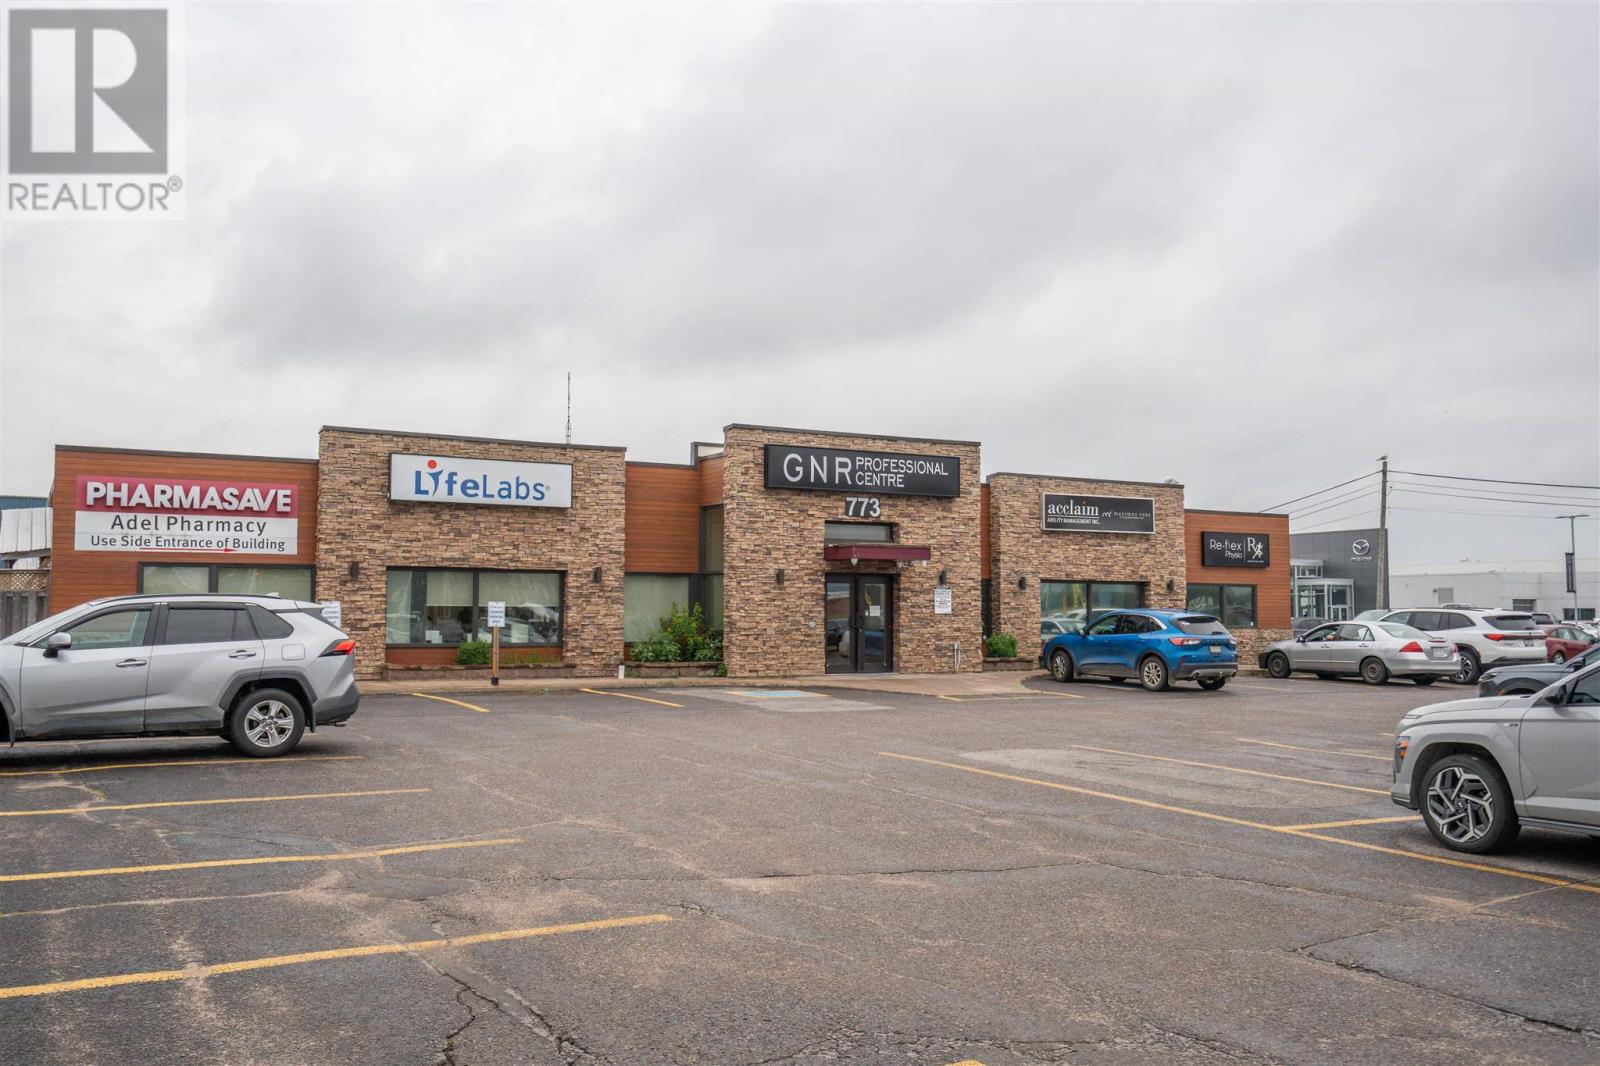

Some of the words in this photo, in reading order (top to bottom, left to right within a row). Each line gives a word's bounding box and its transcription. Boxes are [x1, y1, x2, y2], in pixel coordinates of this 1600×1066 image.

[856, 456, 949, 476] PROFESSIONAL
[855, 472, 905, 487] CENTRE
[86, 481, 291, 513] PHARMASAVE
[846, 497, 880, 518] 773
[1048, 499, 1099, 516] acclaim
[111, 515, 159, 531] Adel
[167, 516, 267, 536] Pharmacy
[91, 535, 117, 547] Use
[121, 535, 151, 547] Side
[156, 536, 213, 549] Entrance
[216, 537, 230, 549] of
[233, 538, 286, 552] Building
[1225, 550, 1243, 560] Physio
